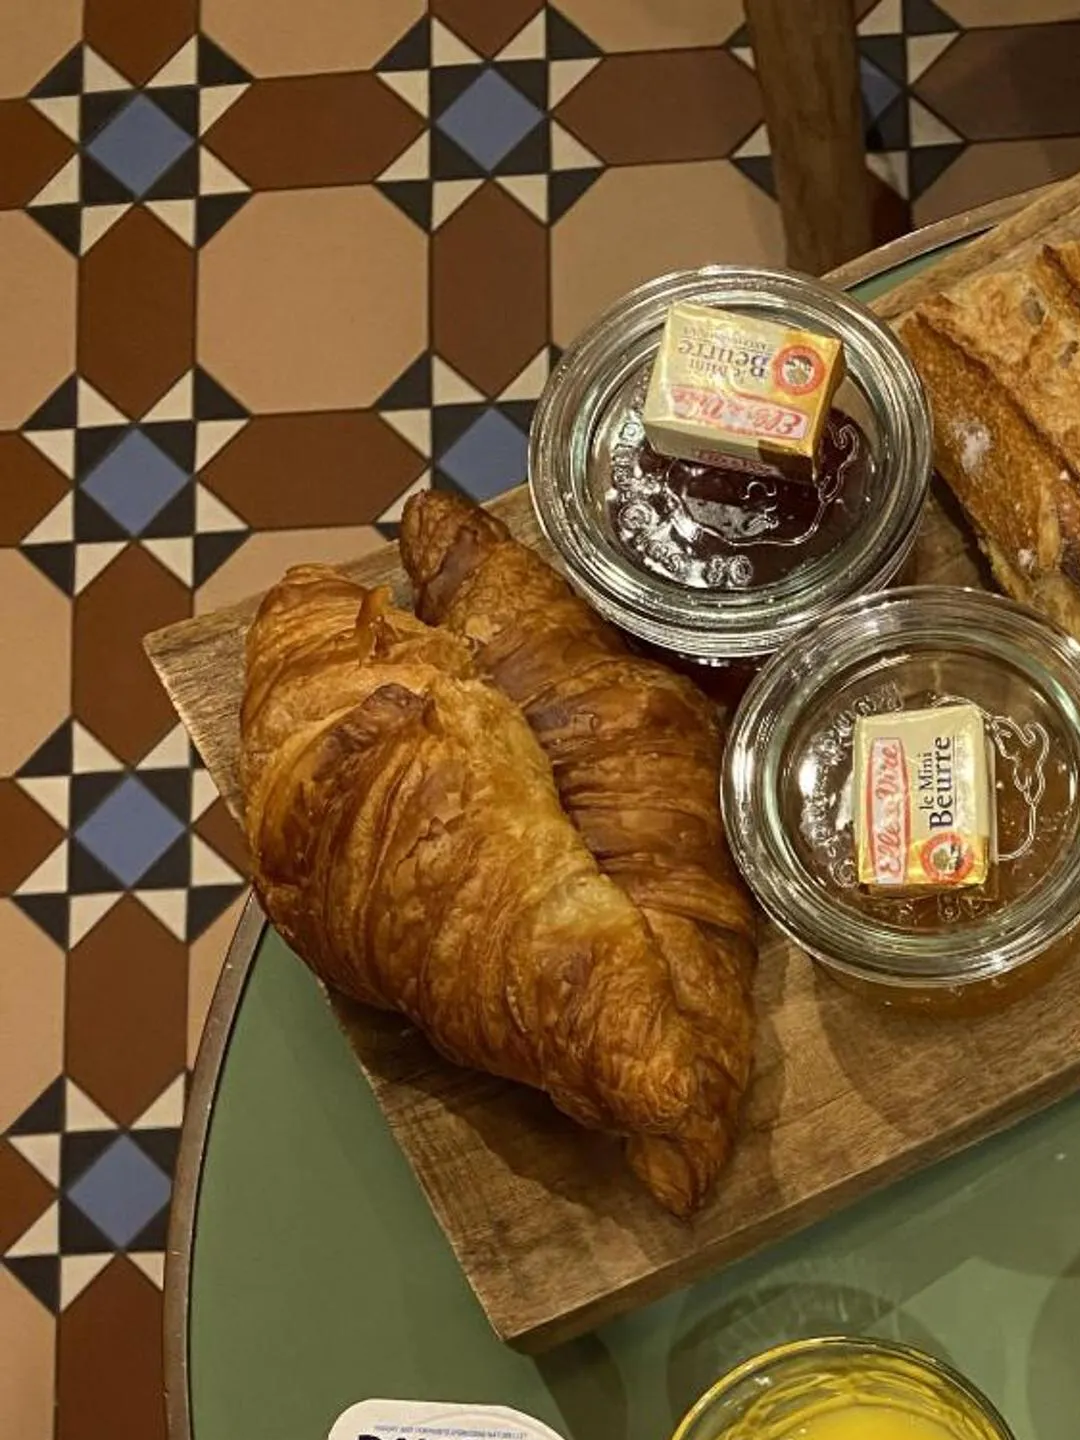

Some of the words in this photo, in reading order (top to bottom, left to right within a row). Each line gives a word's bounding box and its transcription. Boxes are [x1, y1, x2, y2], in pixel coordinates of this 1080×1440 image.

[917, 752, 933, 791] Mini
[929, 736, 953, 830] Beurre
[918, 796, 934, 810] le
